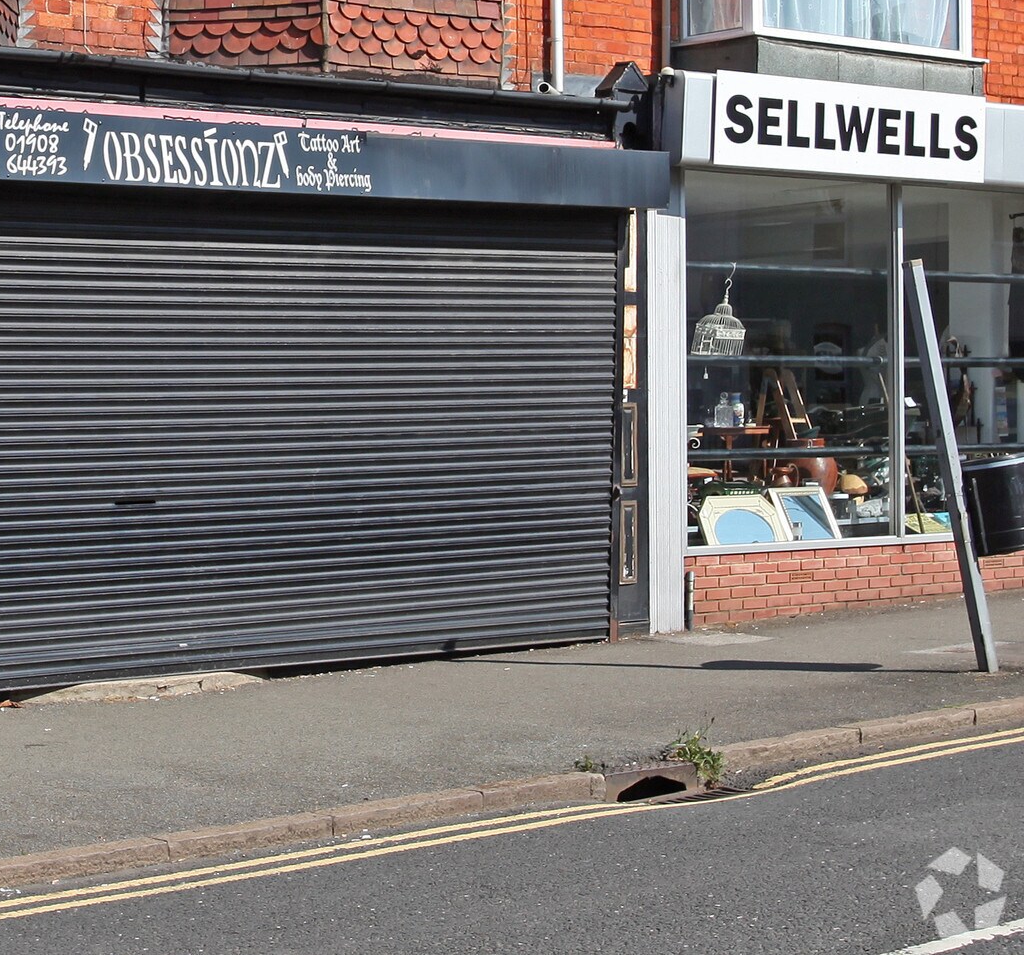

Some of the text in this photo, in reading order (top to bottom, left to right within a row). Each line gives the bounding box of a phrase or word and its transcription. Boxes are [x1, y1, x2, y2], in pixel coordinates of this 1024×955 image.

[723, 94, 979, 161] SELLWELLS
[5, 132, 59, 154] 01908
[297, 131, 361, 153] Tattoo Art
[6, 153, 68, 176] 644393
[327, 152, 338, 172] &
[323, 168, 372, 192] Piercing
